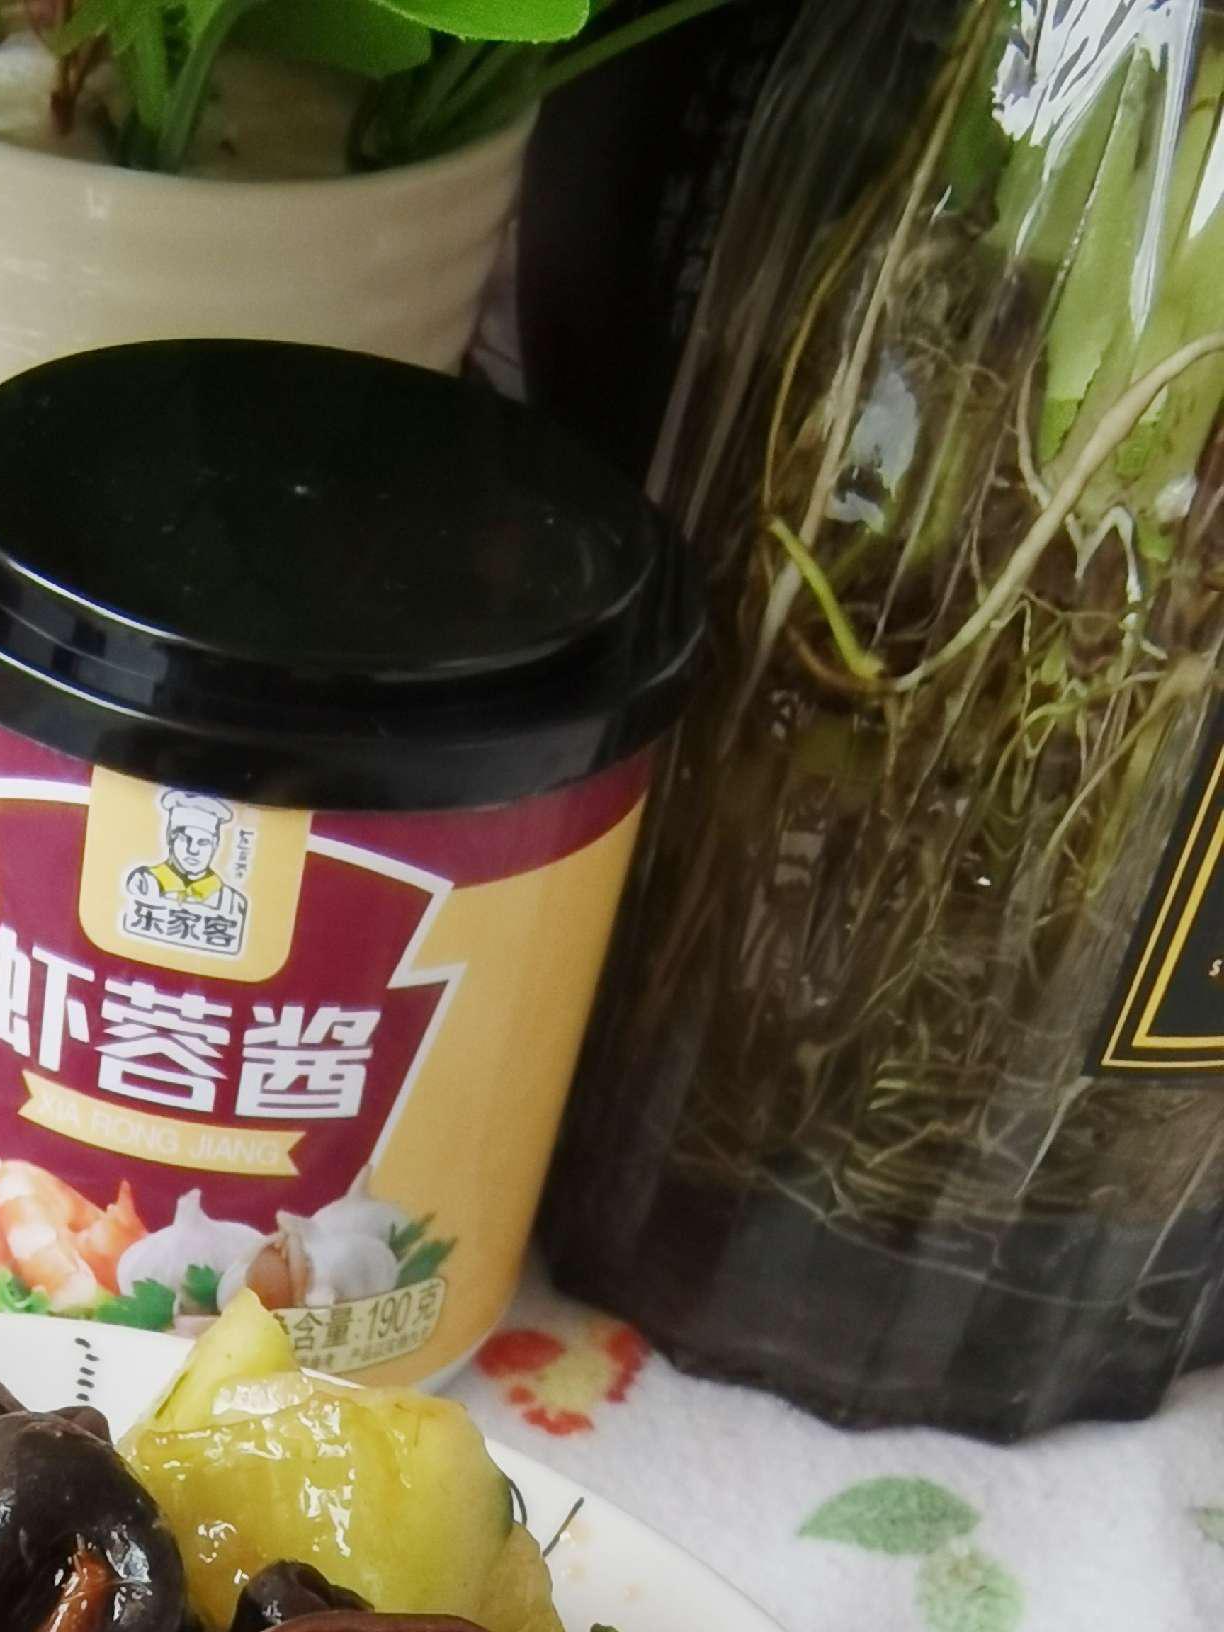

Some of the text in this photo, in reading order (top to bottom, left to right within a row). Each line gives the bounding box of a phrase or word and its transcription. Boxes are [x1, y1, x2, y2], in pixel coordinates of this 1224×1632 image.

[130, 899, 238, 948] 乐家客
[37, 1094, 279, 1165] XIA RONG JIANG
